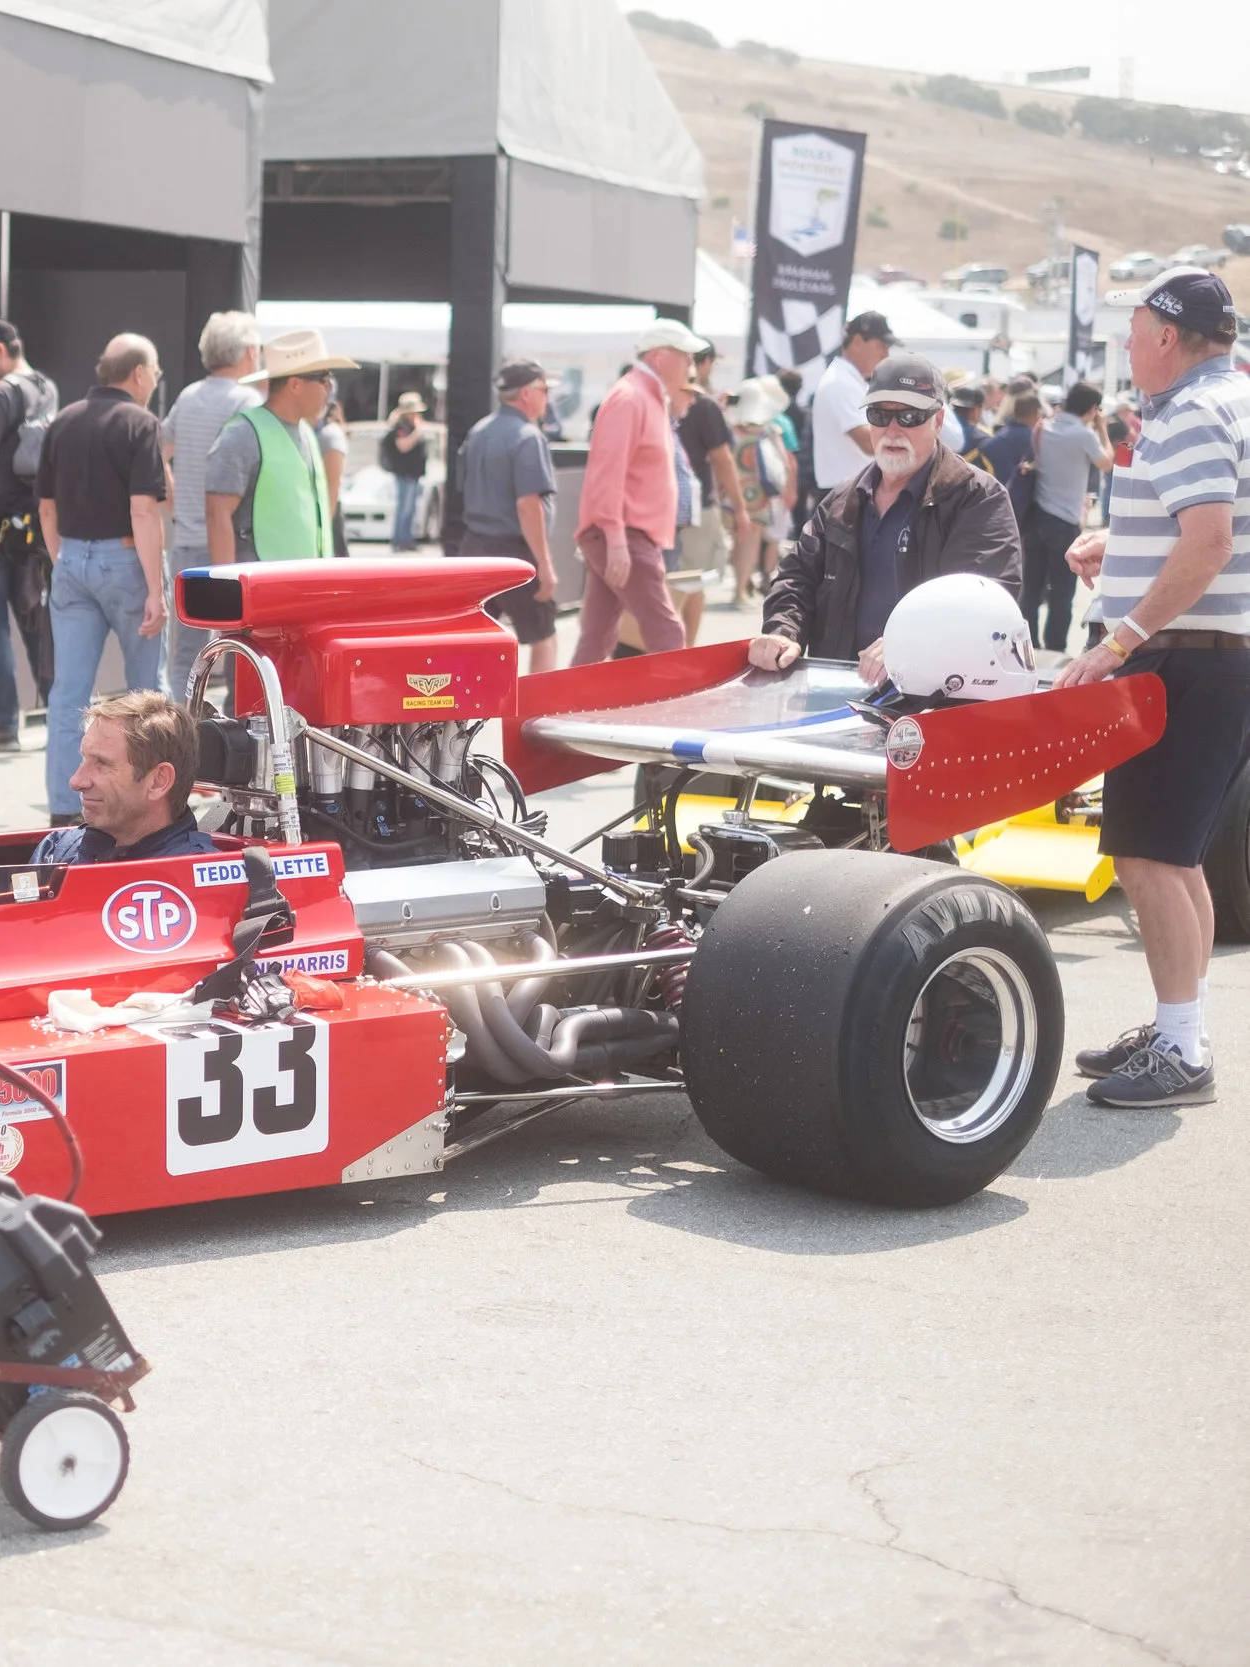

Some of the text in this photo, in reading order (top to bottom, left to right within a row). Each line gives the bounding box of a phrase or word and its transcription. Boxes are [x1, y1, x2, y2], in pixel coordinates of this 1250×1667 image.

[408, 676, 449, 693] CHEVRON
[273, 857, 326, 876] LETTE
[117, 890, 181, 942] STP
[902, 890, 1014, 963] AVON
[284, 954, 345, 973] HARRIS
[159, 1023, 317, 1147] 33
